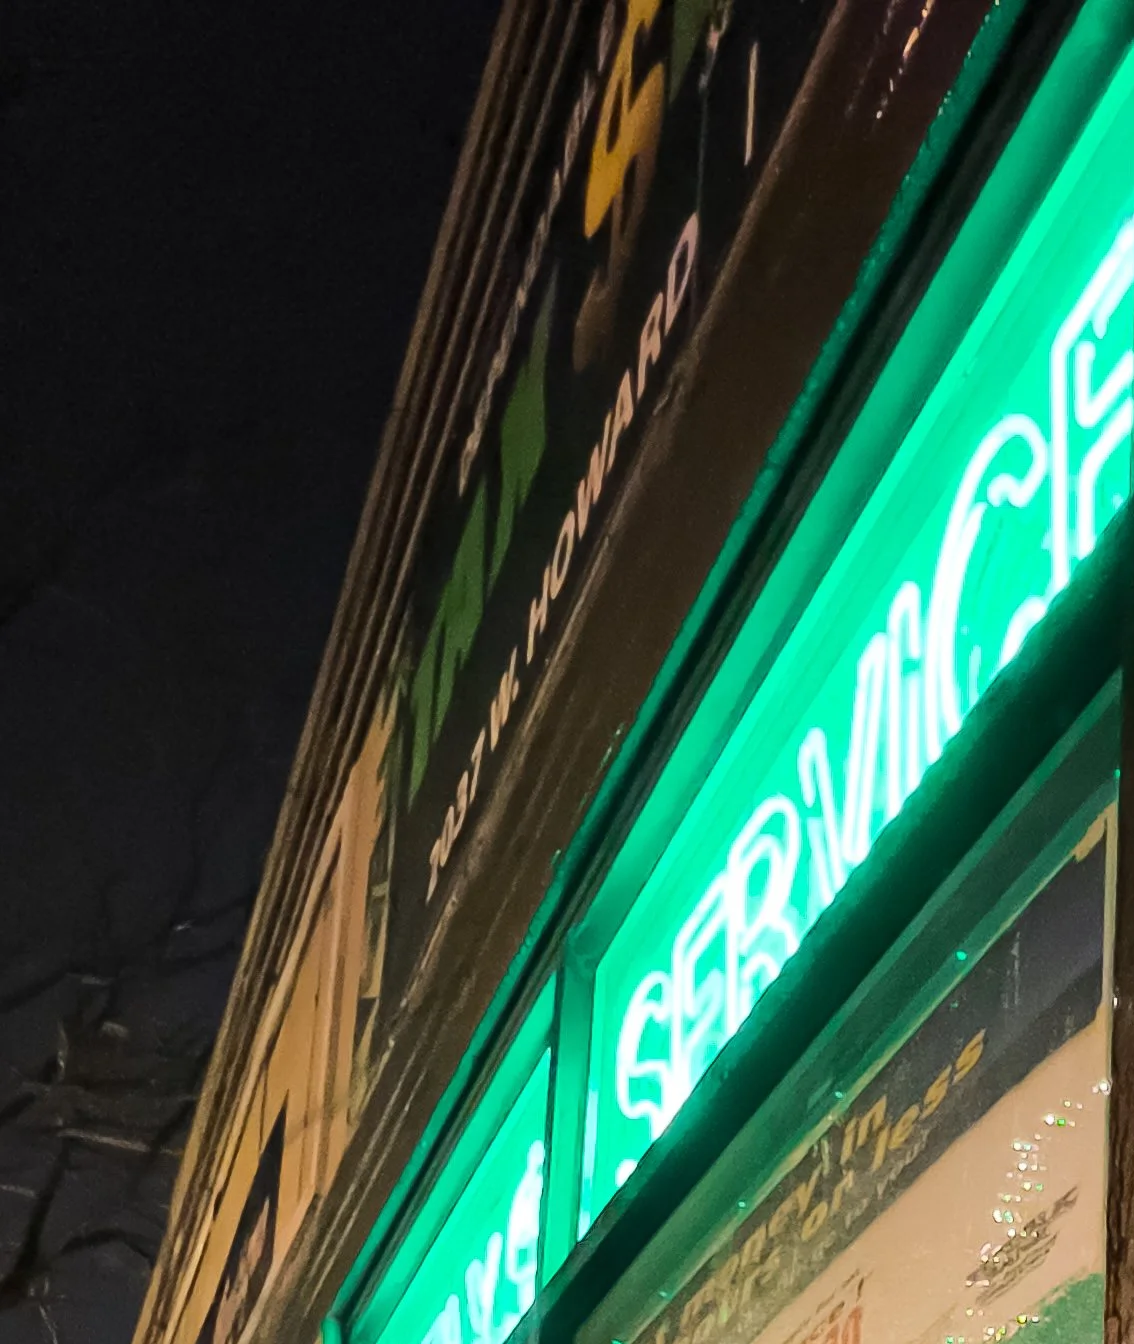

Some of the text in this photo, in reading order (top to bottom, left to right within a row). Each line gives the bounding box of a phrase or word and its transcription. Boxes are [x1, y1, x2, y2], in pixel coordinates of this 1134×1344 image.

[526, 210, 699, 666] HOWARD
[801, 1166, 855, 1245] or
[872, 1027, 987, 1173] less
[841, 1094, 888, 1166] in
